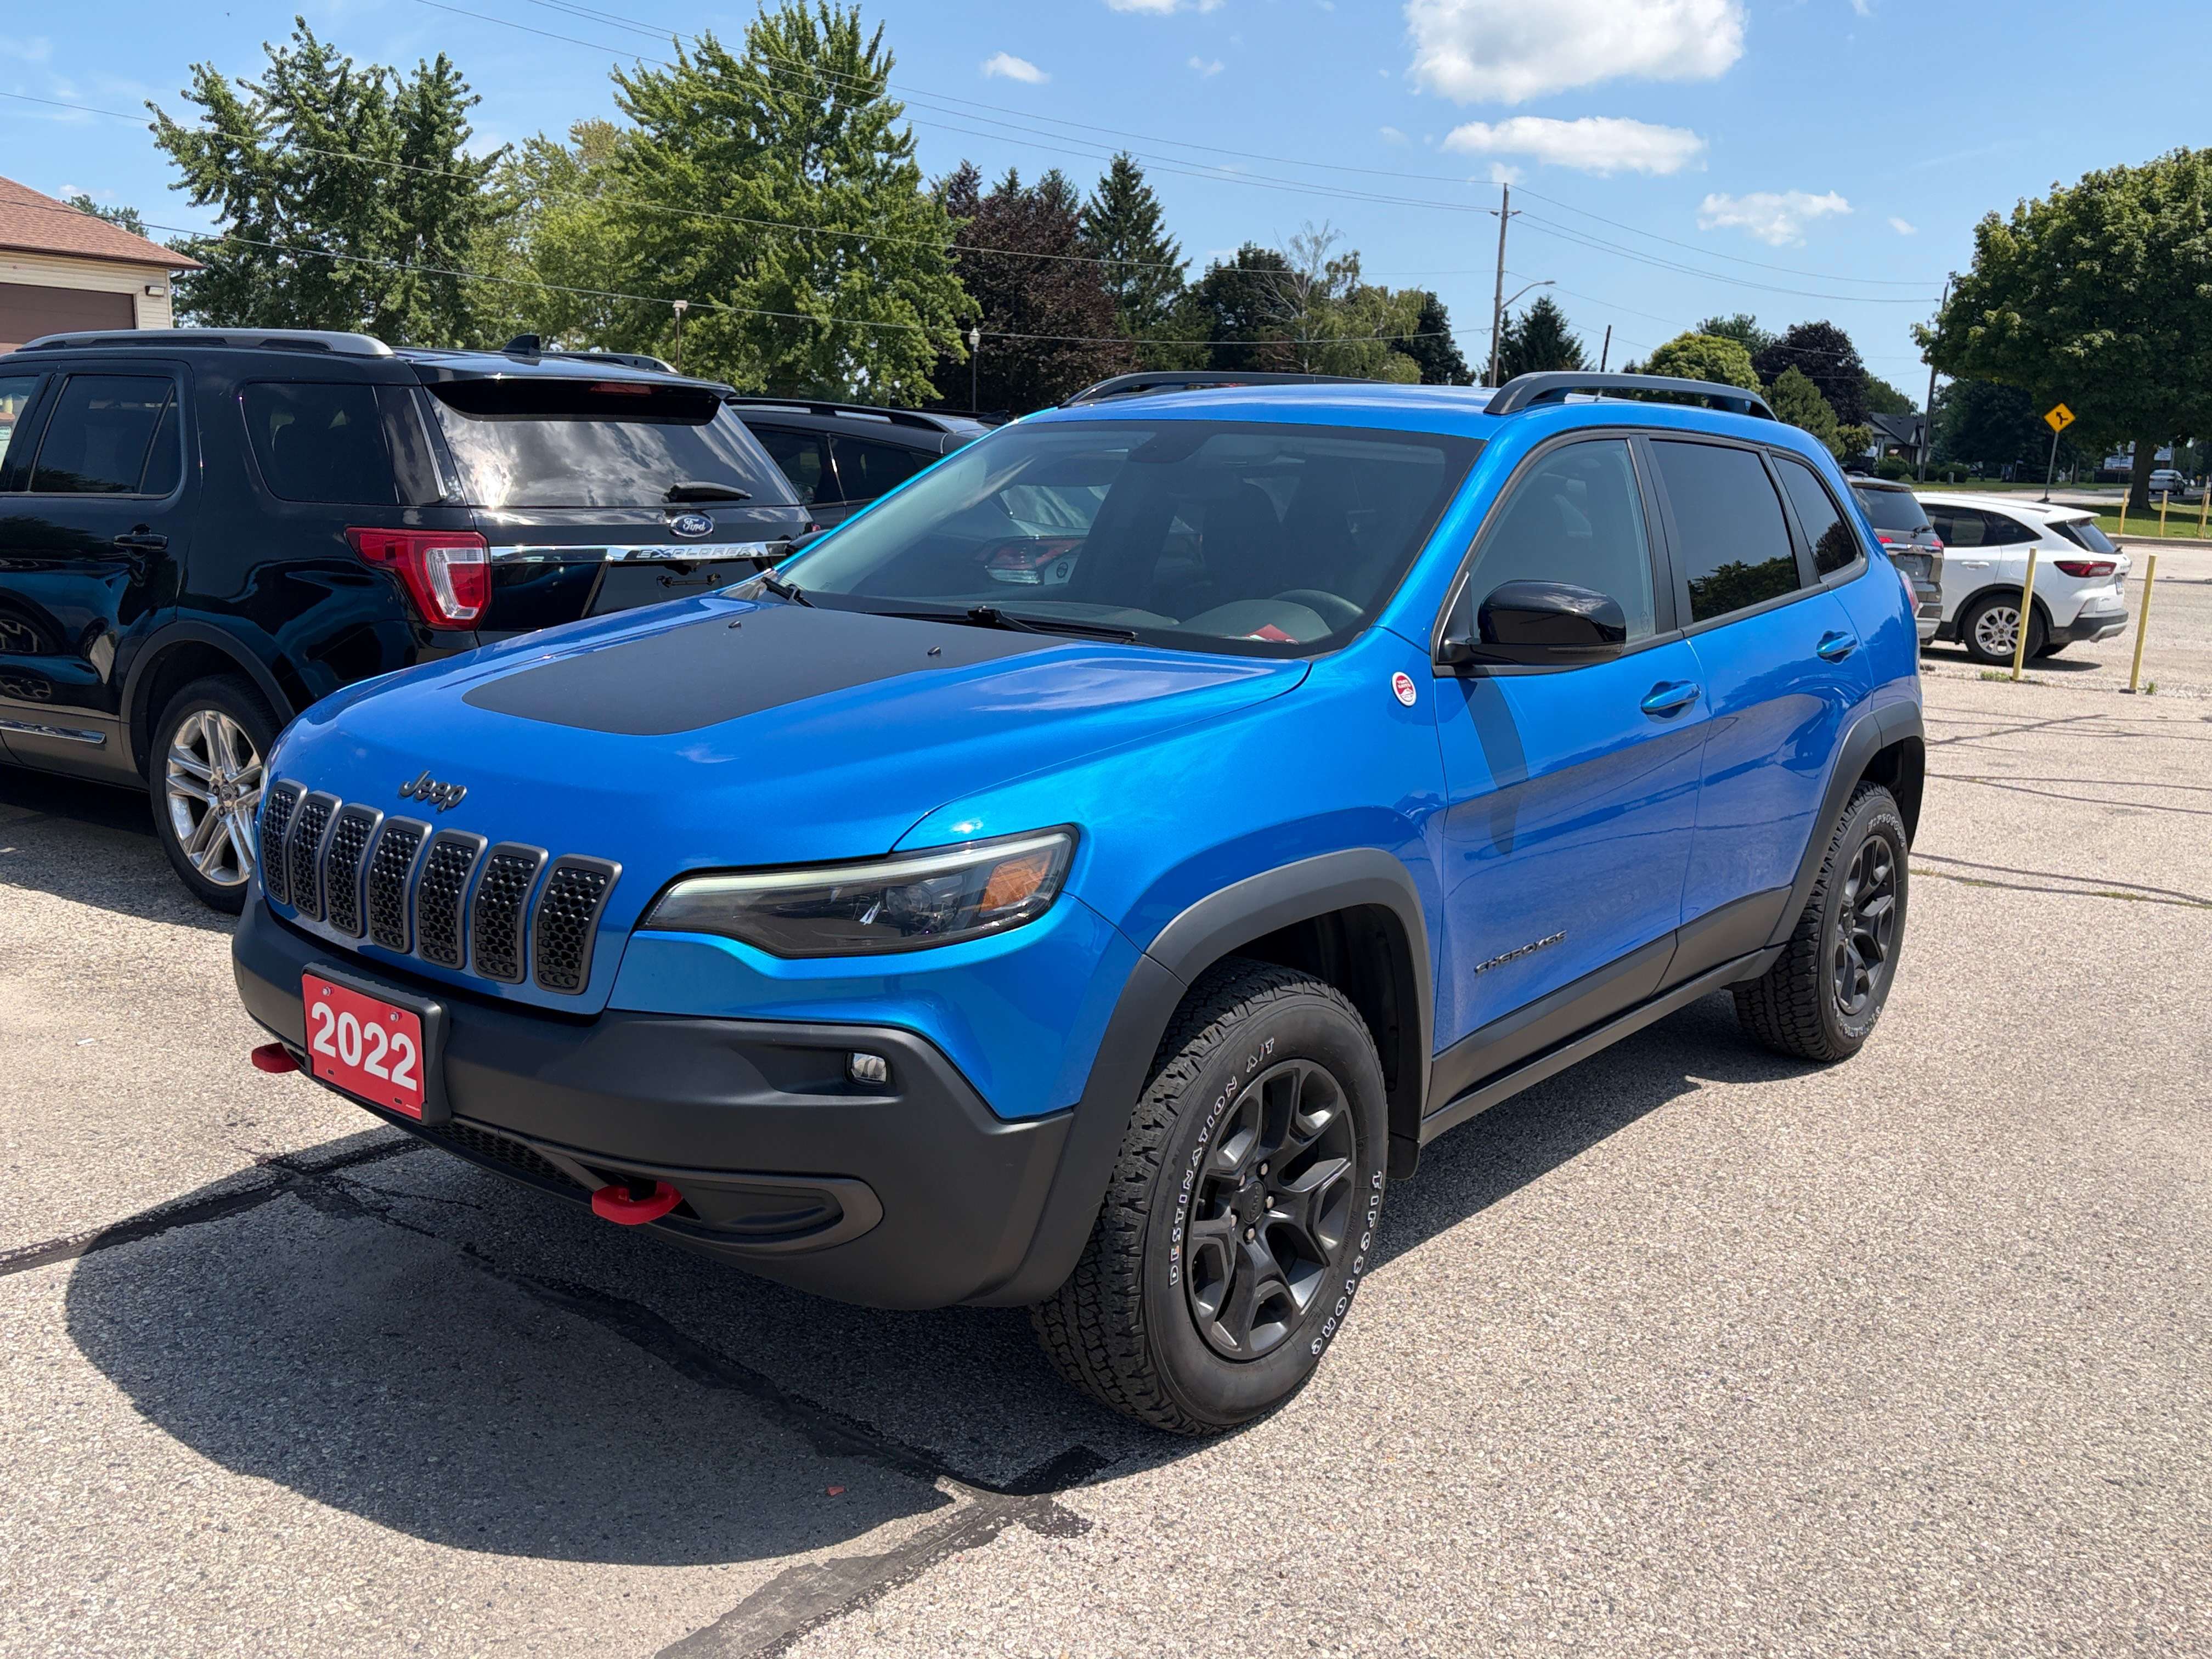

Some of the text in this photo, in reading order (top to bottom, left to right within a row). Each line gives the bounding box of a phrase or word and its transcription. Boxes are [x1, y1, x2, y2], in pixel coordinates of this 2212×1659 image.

[683, 518, 706, 531] Ford
[636, 546, 752, 558] EXPLORER
[400, 770, 467, 811] Jeep
[312, 1002, 417, 1091] 2022
[1170, 1037, 1275, 1286] DESTINATION A/T
